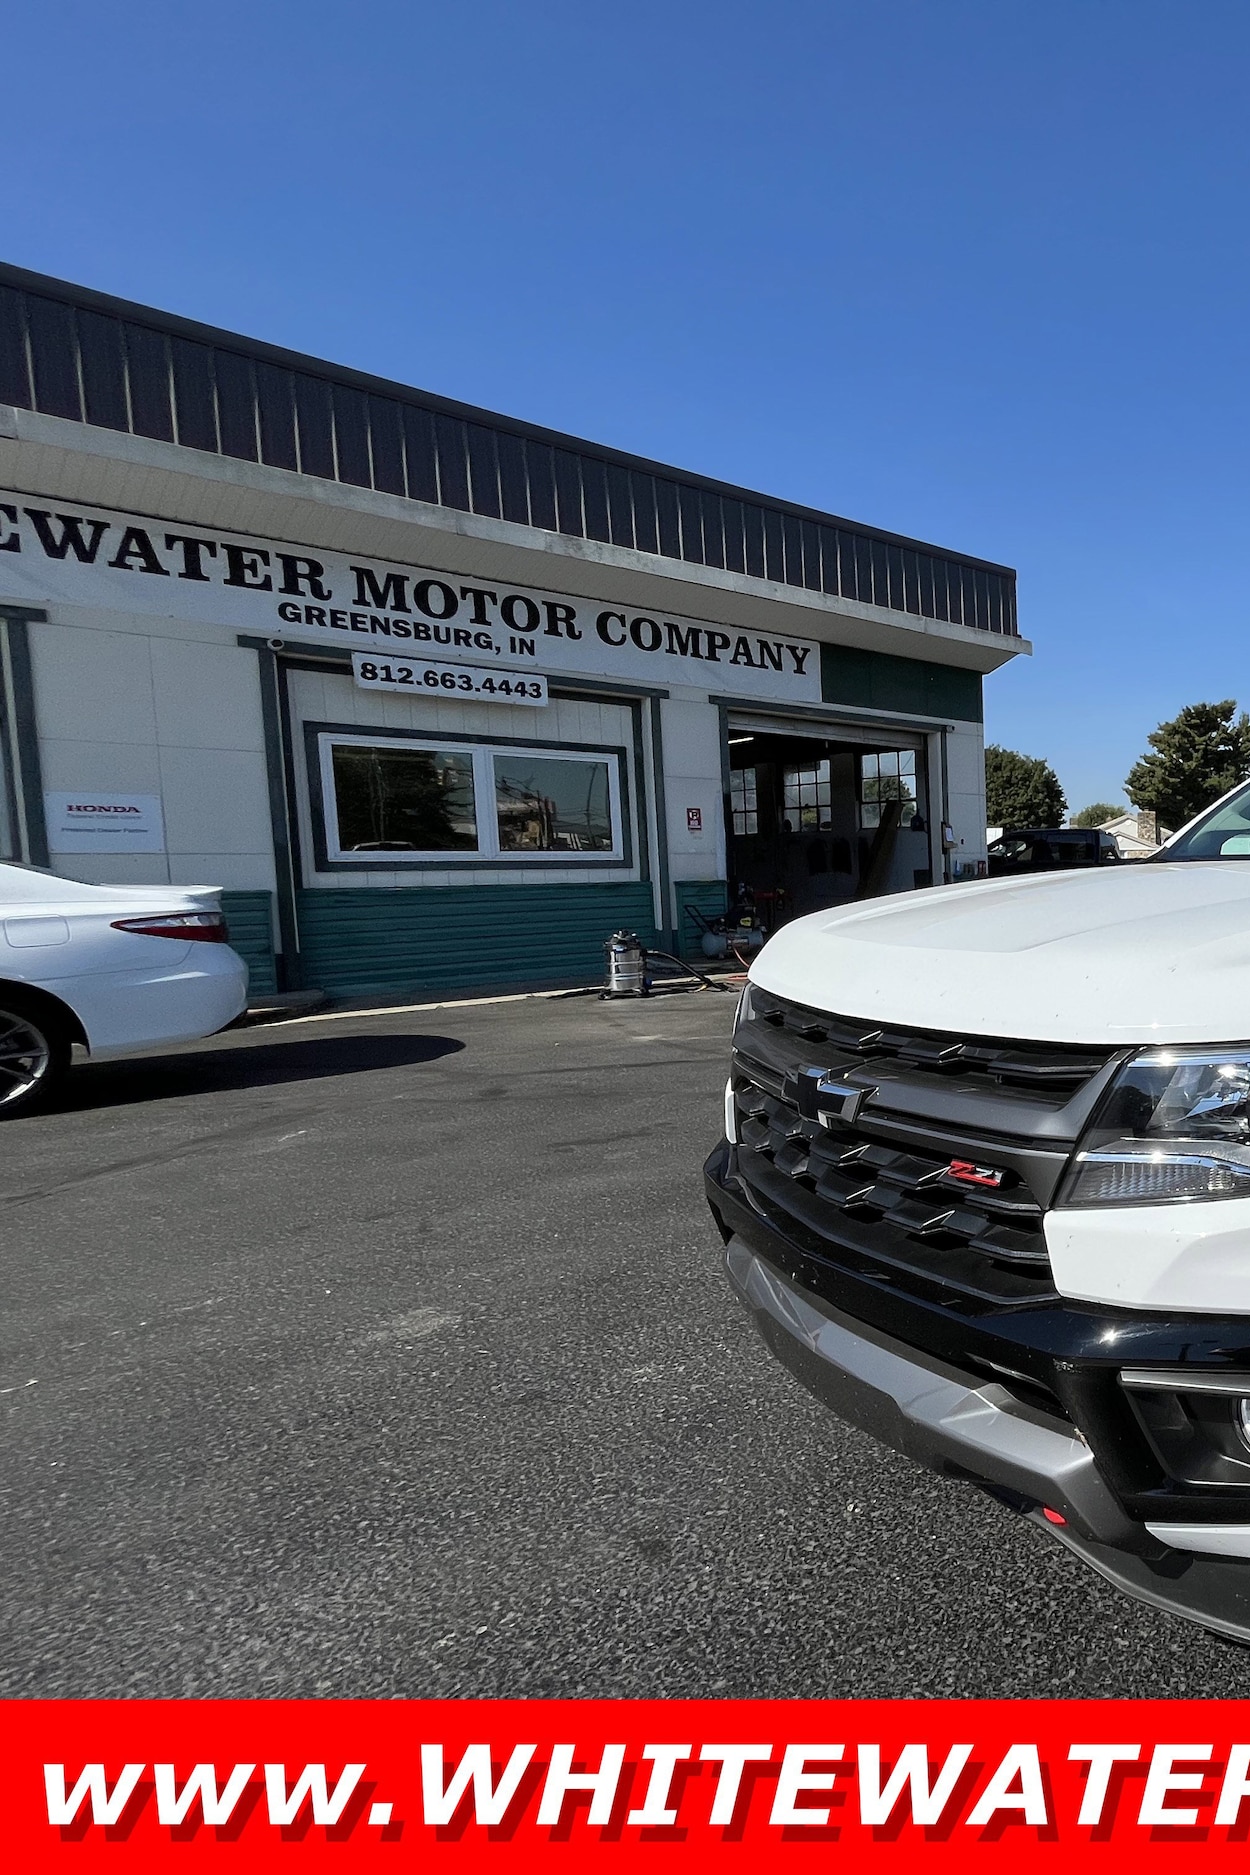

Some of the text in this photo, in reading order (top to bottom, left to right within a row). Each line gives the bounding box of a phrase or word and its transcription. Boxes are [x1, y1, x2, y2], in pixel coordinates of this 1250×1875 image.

[277, 601, 536, 656] GREENSBURG, IN
[349, 565, 583, 641] MOTOR
[595, 610, 812, 676] COMPANY
[360, 662, 542, 699] 812.663.4443
[67, 804, 142, 814] HONDA
